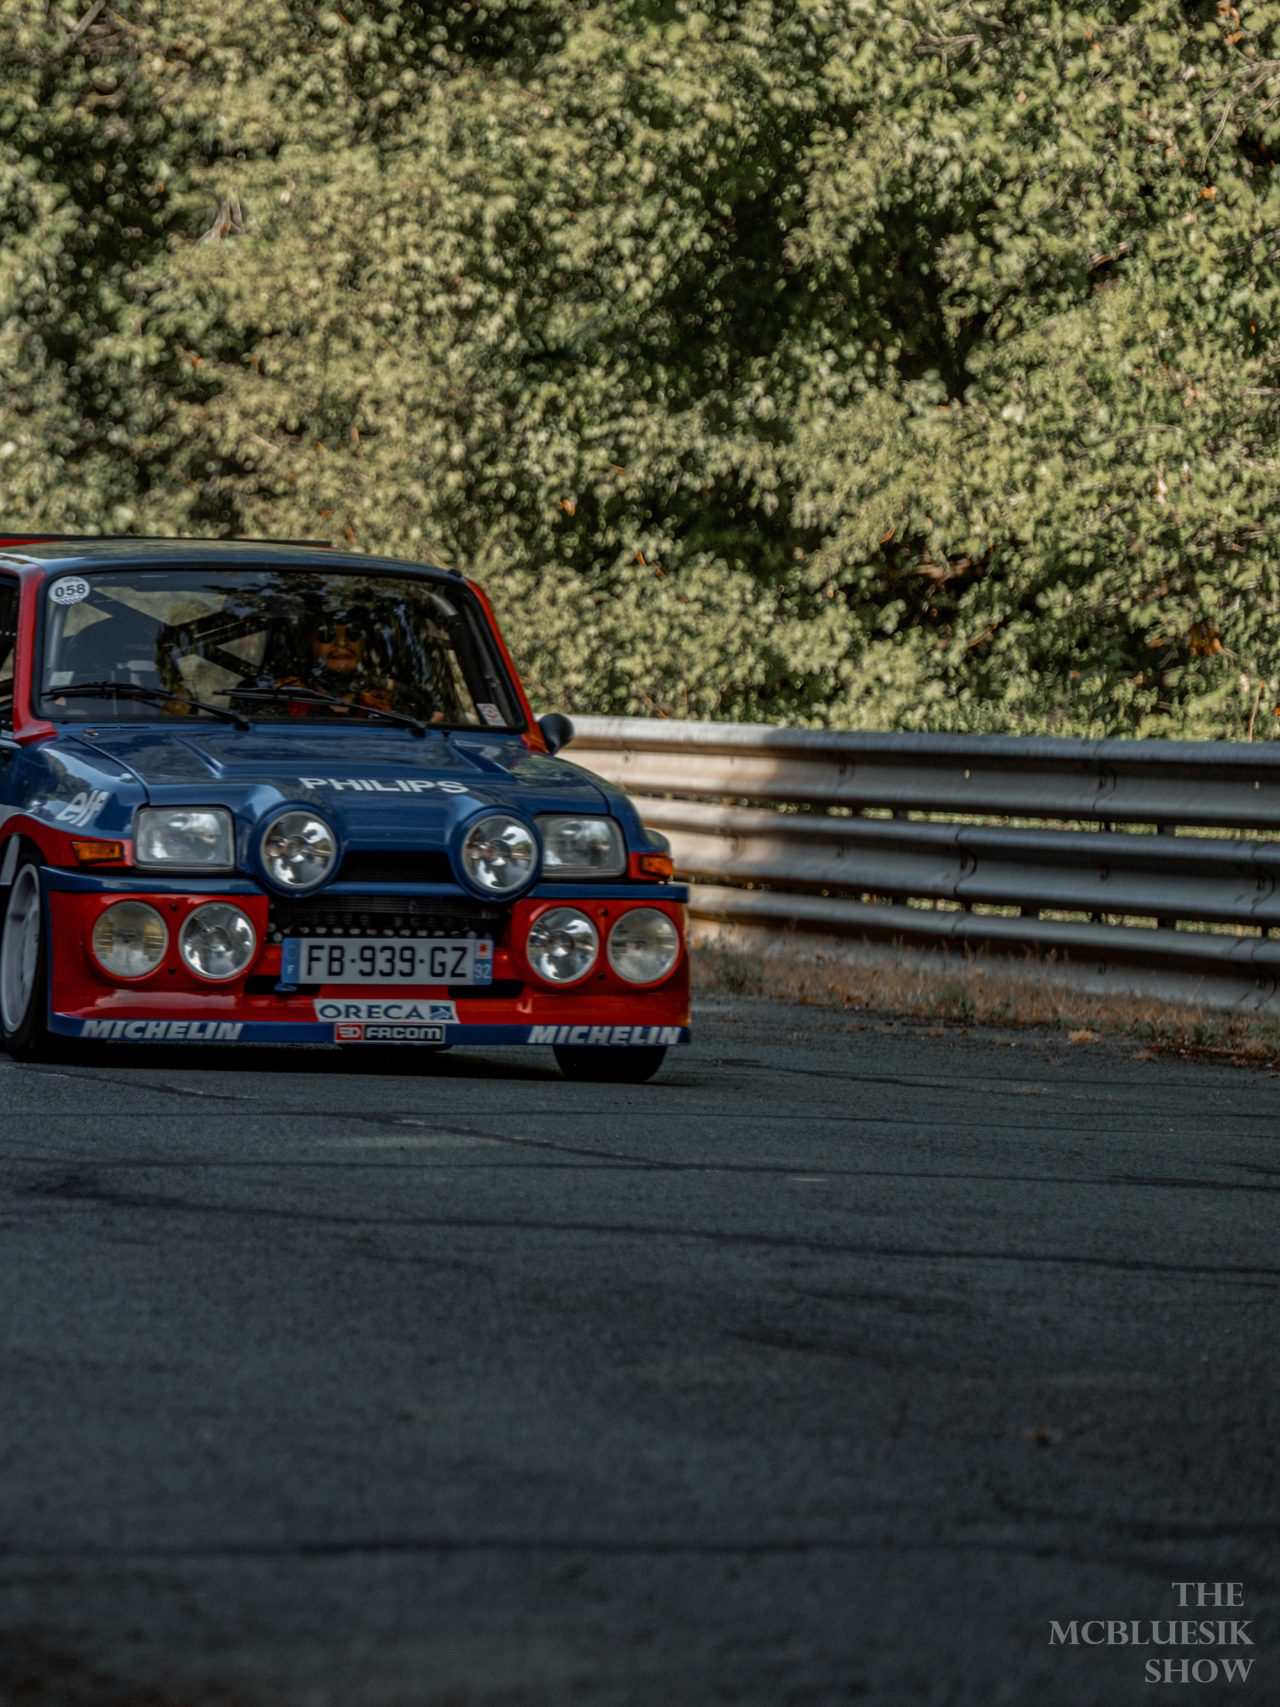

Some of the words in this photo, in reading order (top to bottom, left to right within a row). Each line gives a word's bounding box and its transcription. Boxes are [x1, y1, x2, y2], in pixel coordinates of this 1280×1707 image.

[55, 583, 86, 598] 058
[298, 777, 469, 794] PHILIPS
[55, 789, 110, 828] elf
[287, 964, 294, 974] F
[474, 963, 492, 979] 92
[319, 1004, 424, 1020] ORECA
[80, 1020, 244, 1040] MICHELIN
[365, 1026, 441, 1040] FACOM
[527, 1025, 682, 1044] MICHELIN
